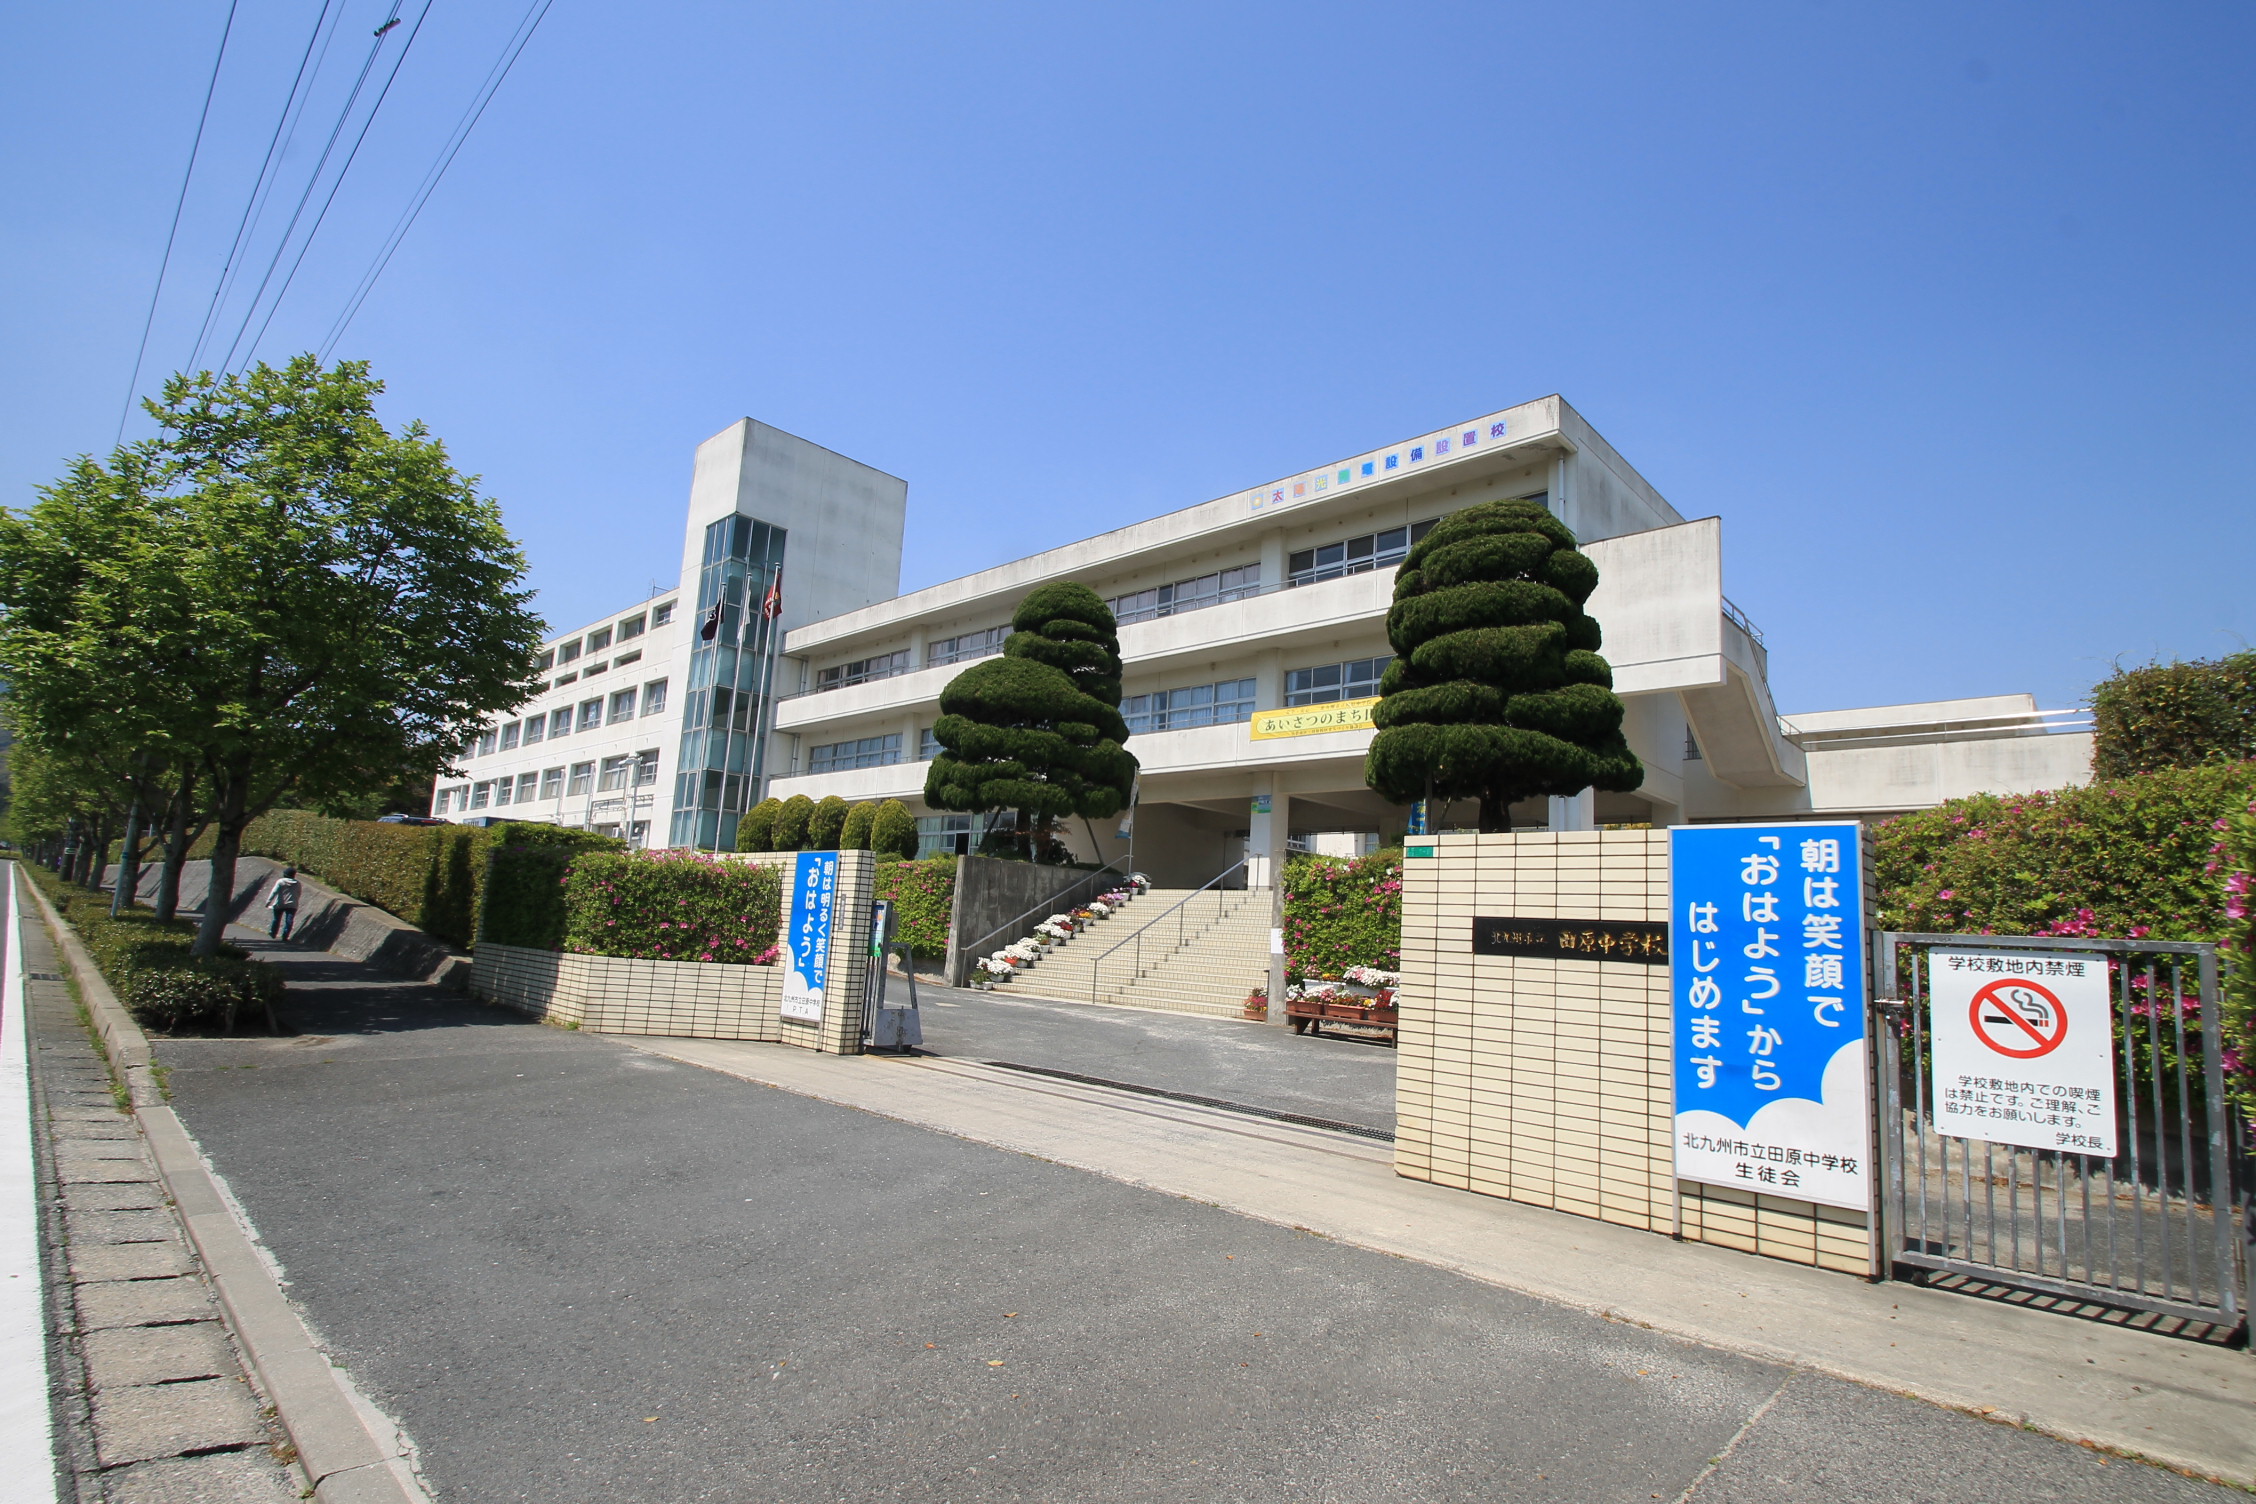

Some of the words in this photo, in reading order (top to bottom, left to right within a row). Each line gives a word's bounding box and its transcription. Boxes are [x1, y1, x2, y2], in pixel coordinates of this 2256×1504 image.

[798, 857, 821, 967] 「おはよう」
[813, 861, 834, 983] 朝は明るく笑顔で
[1800, 839, 1845, 1027] 朝は笑顔で
[1740, 836, 1782, 1090] 「おはよう」から
[1948, 956, 2086, 978] 学校敷地内禁煙
[1689, 901, 1723, 1089] はじめます
[1944, 1088, 2101, 1116] は禁止です。ご理解、ご
[1958, 1075, 2101, 1101] 学校敷地内での喫煙
[1944, 1102, 2081, 1128] 協力をお願いします。
[1682, 1131, 1858, 1175] 北九州市立田原中学校
[2056, 1132, 2103, 1149] 学校長
[1735, 1161, 1801, 1187] 生徒会
